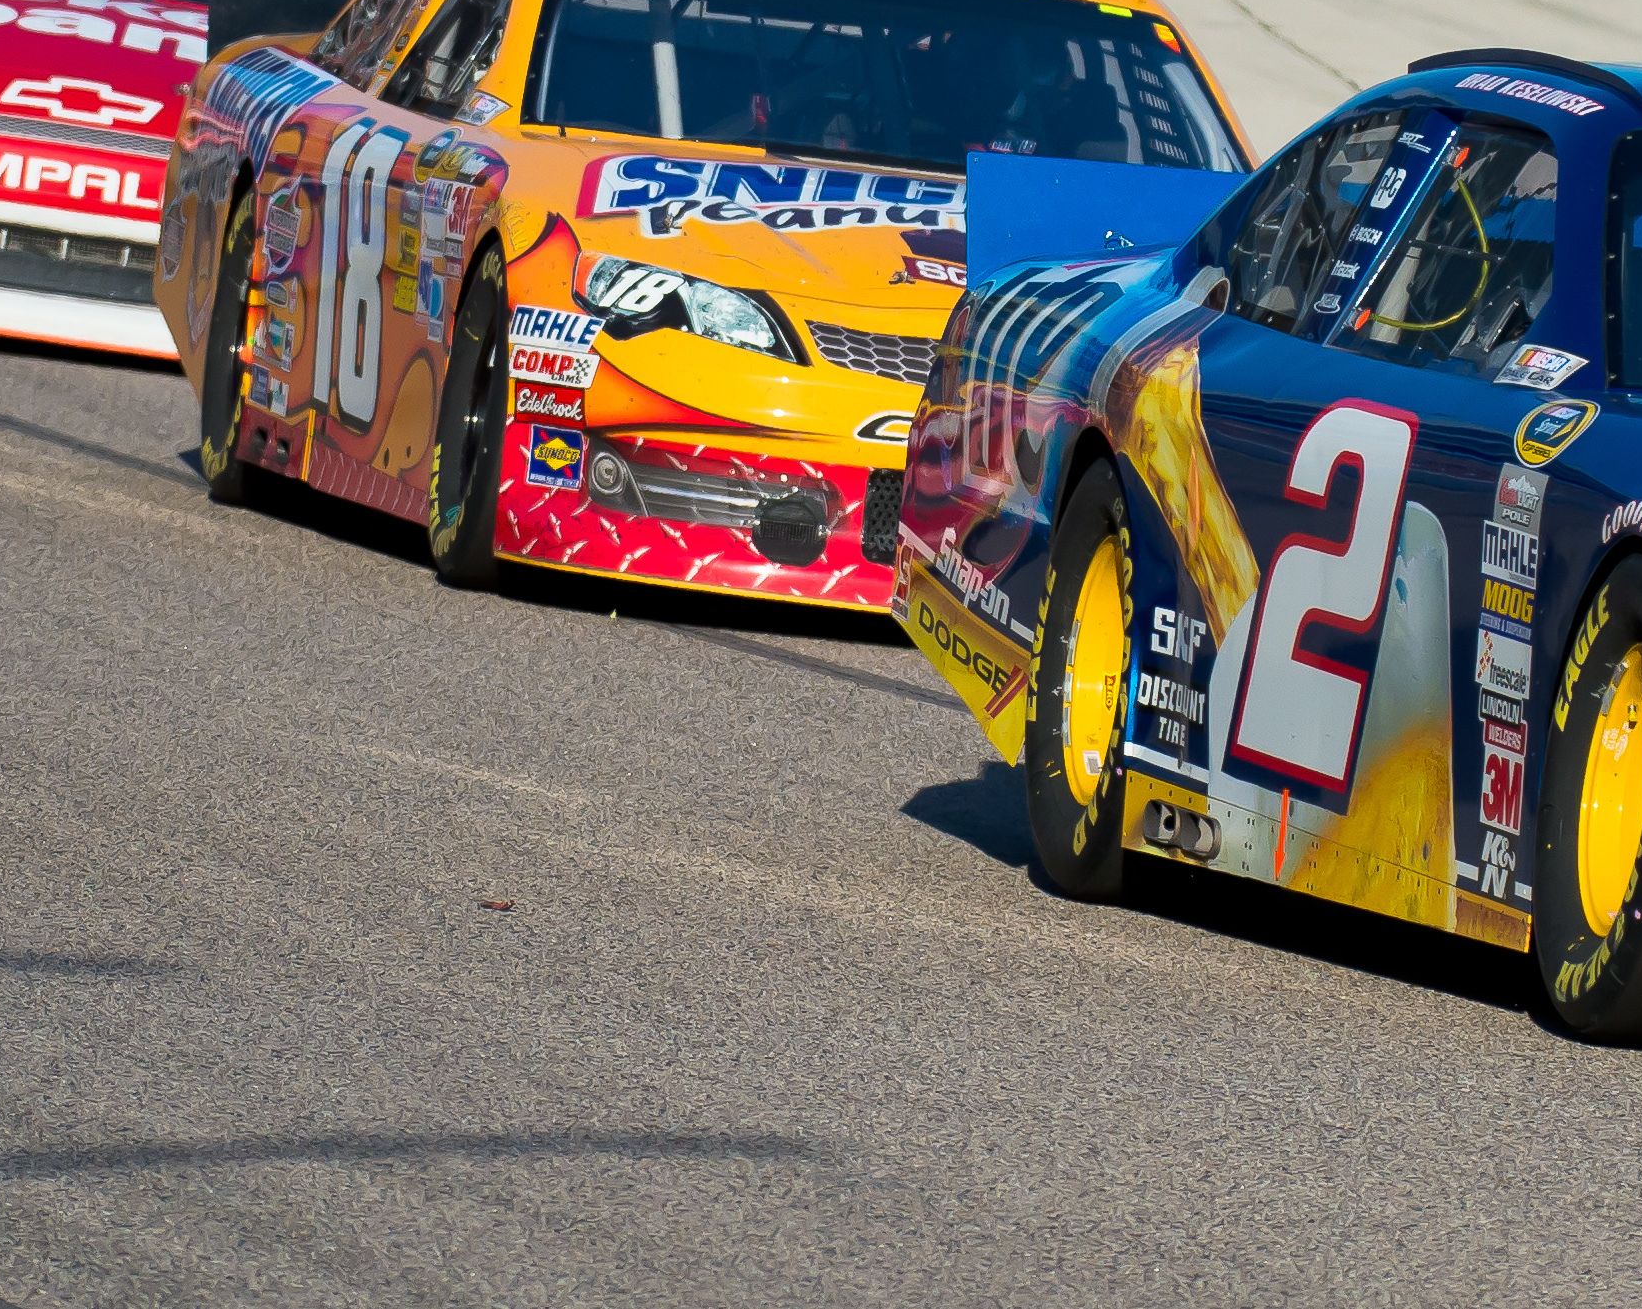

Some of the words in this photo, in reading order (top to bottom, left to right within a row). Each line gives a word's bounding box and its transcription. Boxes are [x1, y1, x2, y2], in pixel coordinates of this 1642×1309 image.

[1455, 73, 1495, 92] BRAD
[1496, 76, 1606, 116] KESELOWSKI
[313, 117, 410, 430] 18
[600, 268, 686, 313] 18
[511, 306, 603, 346] MAHLE
[513, 348, 574, 375] COMP
[551, 372, 583, 385] CAMS
[1528, 370, 1554, 386] CAR
[517, 388, 583, 421] Edelbrock
[536, 444, 579, 464] SUNOCO
[1501, 508, 1531, 525] POLE
[935, 527, 1010, 625] Snap-on
[1231, 397, 1419, 794] 2
[1482, 578, 1535, 623] MOOG
[919, 602, 1013, 695] DODGE
[1150, 606, 1206, 665] SKF
[1555, 583, 1610, 733] EAGLE
[1137, 672, 1206, 725] DISCOUNT
[1481, 693, 1521, 724] LINCOLN
[1158, 716, 1186, 747] TIRE
[1488, 723, 1522, 750] WELDERS
[1483, 753, 1524, 830] 3M
